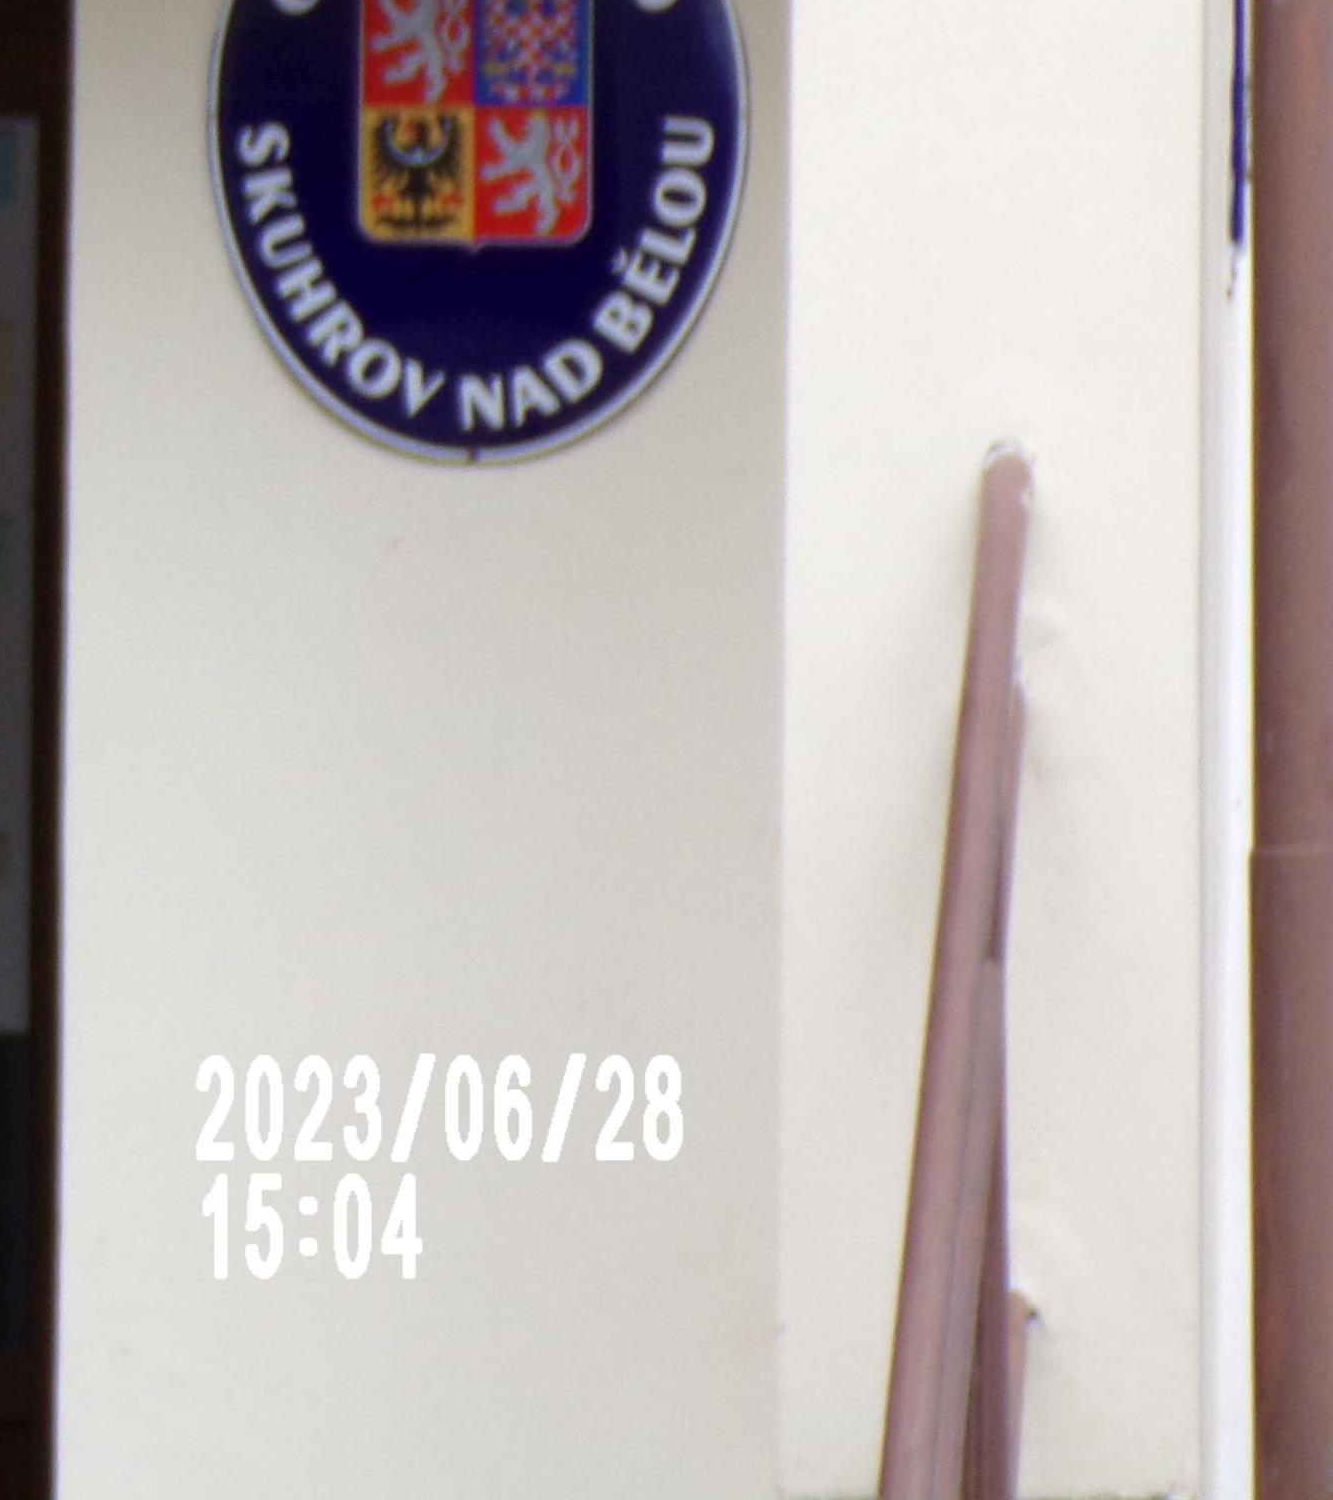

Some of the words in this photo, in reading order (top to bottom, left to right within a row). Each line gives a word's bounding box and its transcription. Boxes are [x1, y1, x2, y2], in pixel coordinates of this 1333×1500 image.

[238, 122, 445, 417] SKUHROV
[457, 339, 604, 431] NAD
[592, 115, 715, 354] BĚLOU
